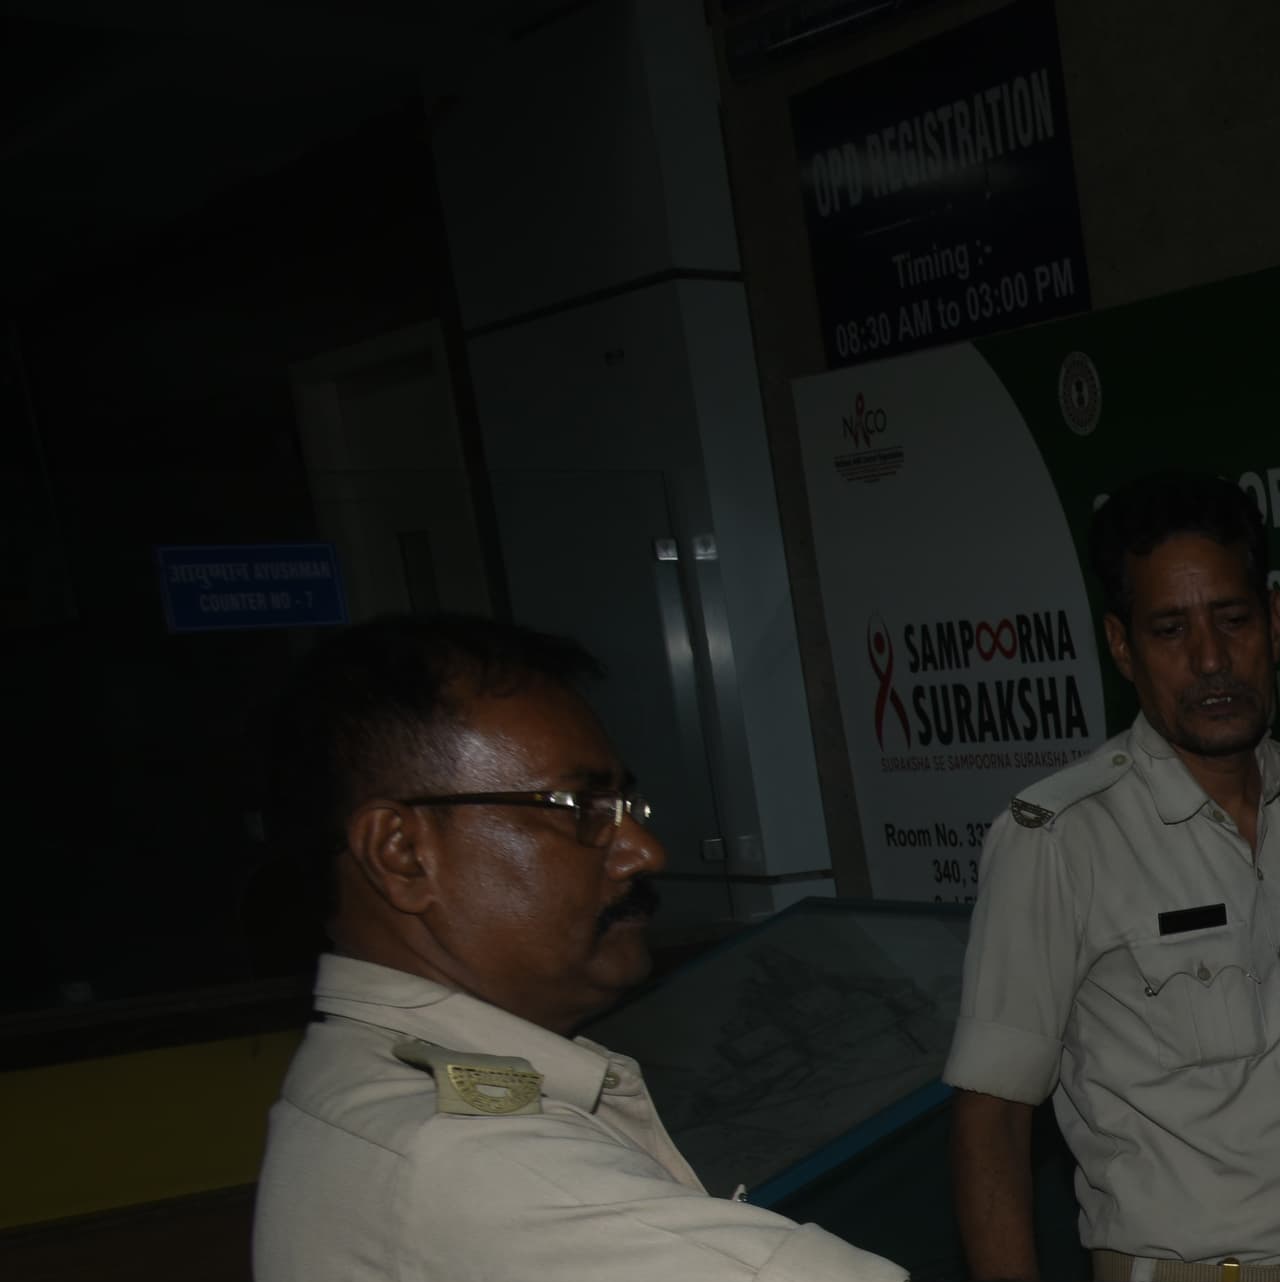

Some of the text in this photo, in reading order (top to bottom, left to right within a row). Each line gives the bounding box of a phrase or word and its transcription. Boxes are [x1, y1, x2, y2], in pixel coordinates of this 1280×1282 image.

[812, 67, 1055, 218] OPD REGISTRATION
[892, 240, 970, 289] Timing
[835, 257, 1075, 359] 08:30 AM to 03:00 PM
[200, 591, 266, 614] COUNTER
[904, 610, 1078, 673] SAMPOORNA
[912, 675, 1089, 746] SURAKSHA
[881, 757, 931, 773] SURAKSHA
[949, 752, 1012, 771] SAMPOORNA
[1015, 750, 1068, 769] SURAKSHA
[884, 823, 932, 848] Room
[934, 821, 963, 848] No.
[932, 859, 966, 889] 340,
